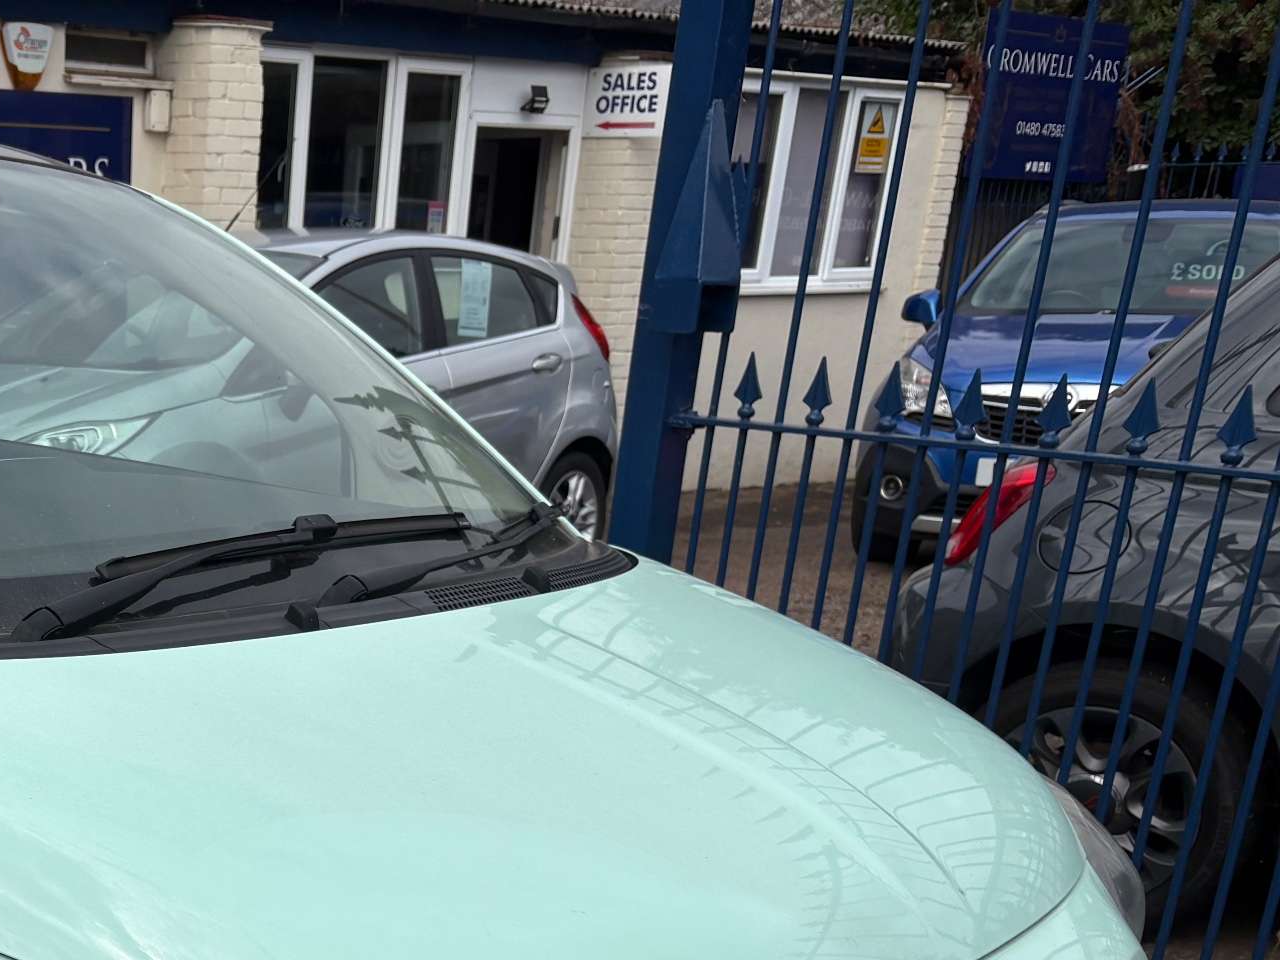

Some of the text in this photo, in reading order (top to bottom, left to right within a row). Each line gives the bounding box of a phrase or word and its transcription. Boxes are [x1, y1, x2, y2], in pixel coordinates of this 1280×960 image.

[602, 72, 657, 91] SALES
[596, 94, 658, 114] OFFICE
[1016, 120, 1041, 136] 01480
